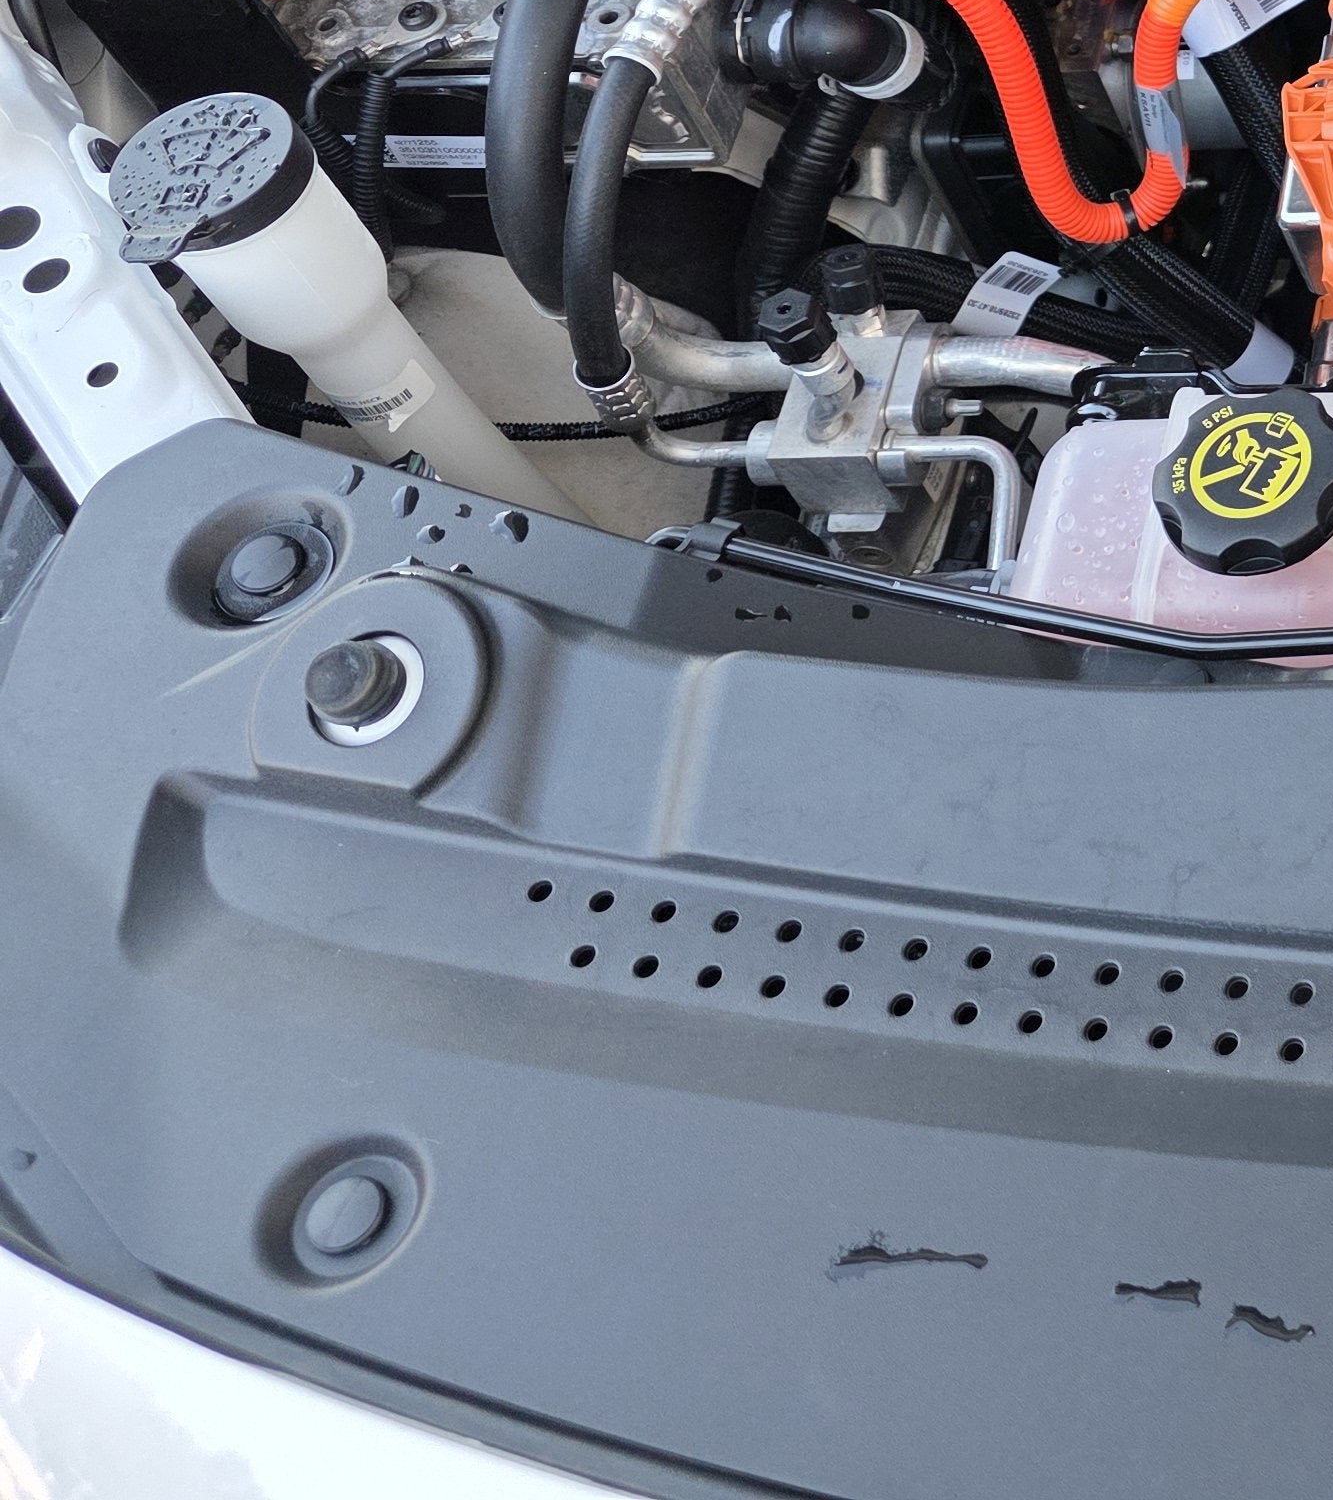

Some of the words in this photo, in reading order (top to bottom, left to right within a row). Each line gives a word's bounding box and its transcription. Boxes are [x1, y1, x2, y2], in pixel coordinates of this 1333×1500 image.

[1211, 405, 1235, 423] PSI
[1171, 457, 1187, 481] kPa
[1171, 481, 1185, 494] 35
